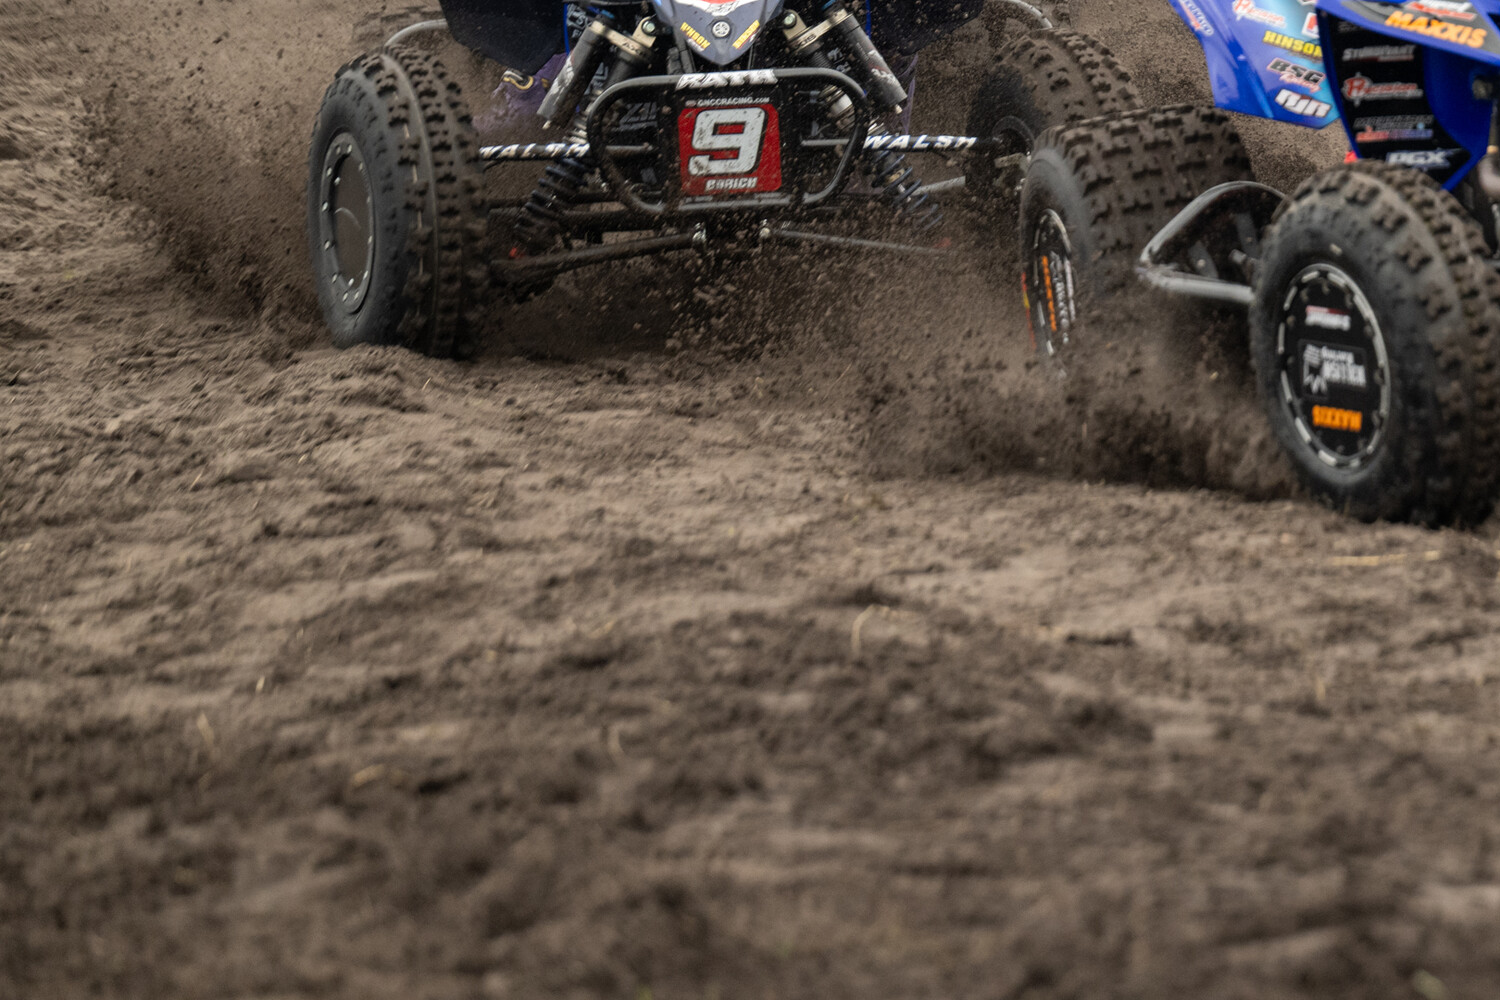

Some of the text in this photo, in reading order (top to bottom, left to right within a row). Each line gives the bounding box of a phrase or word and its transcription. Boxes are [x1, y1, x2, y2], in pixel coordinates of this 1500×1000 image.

[1385, 10, 1488, 48] MAXXIS
[688, 107, 767, 176] 9
[863, 134, 978, 149] WALSH
